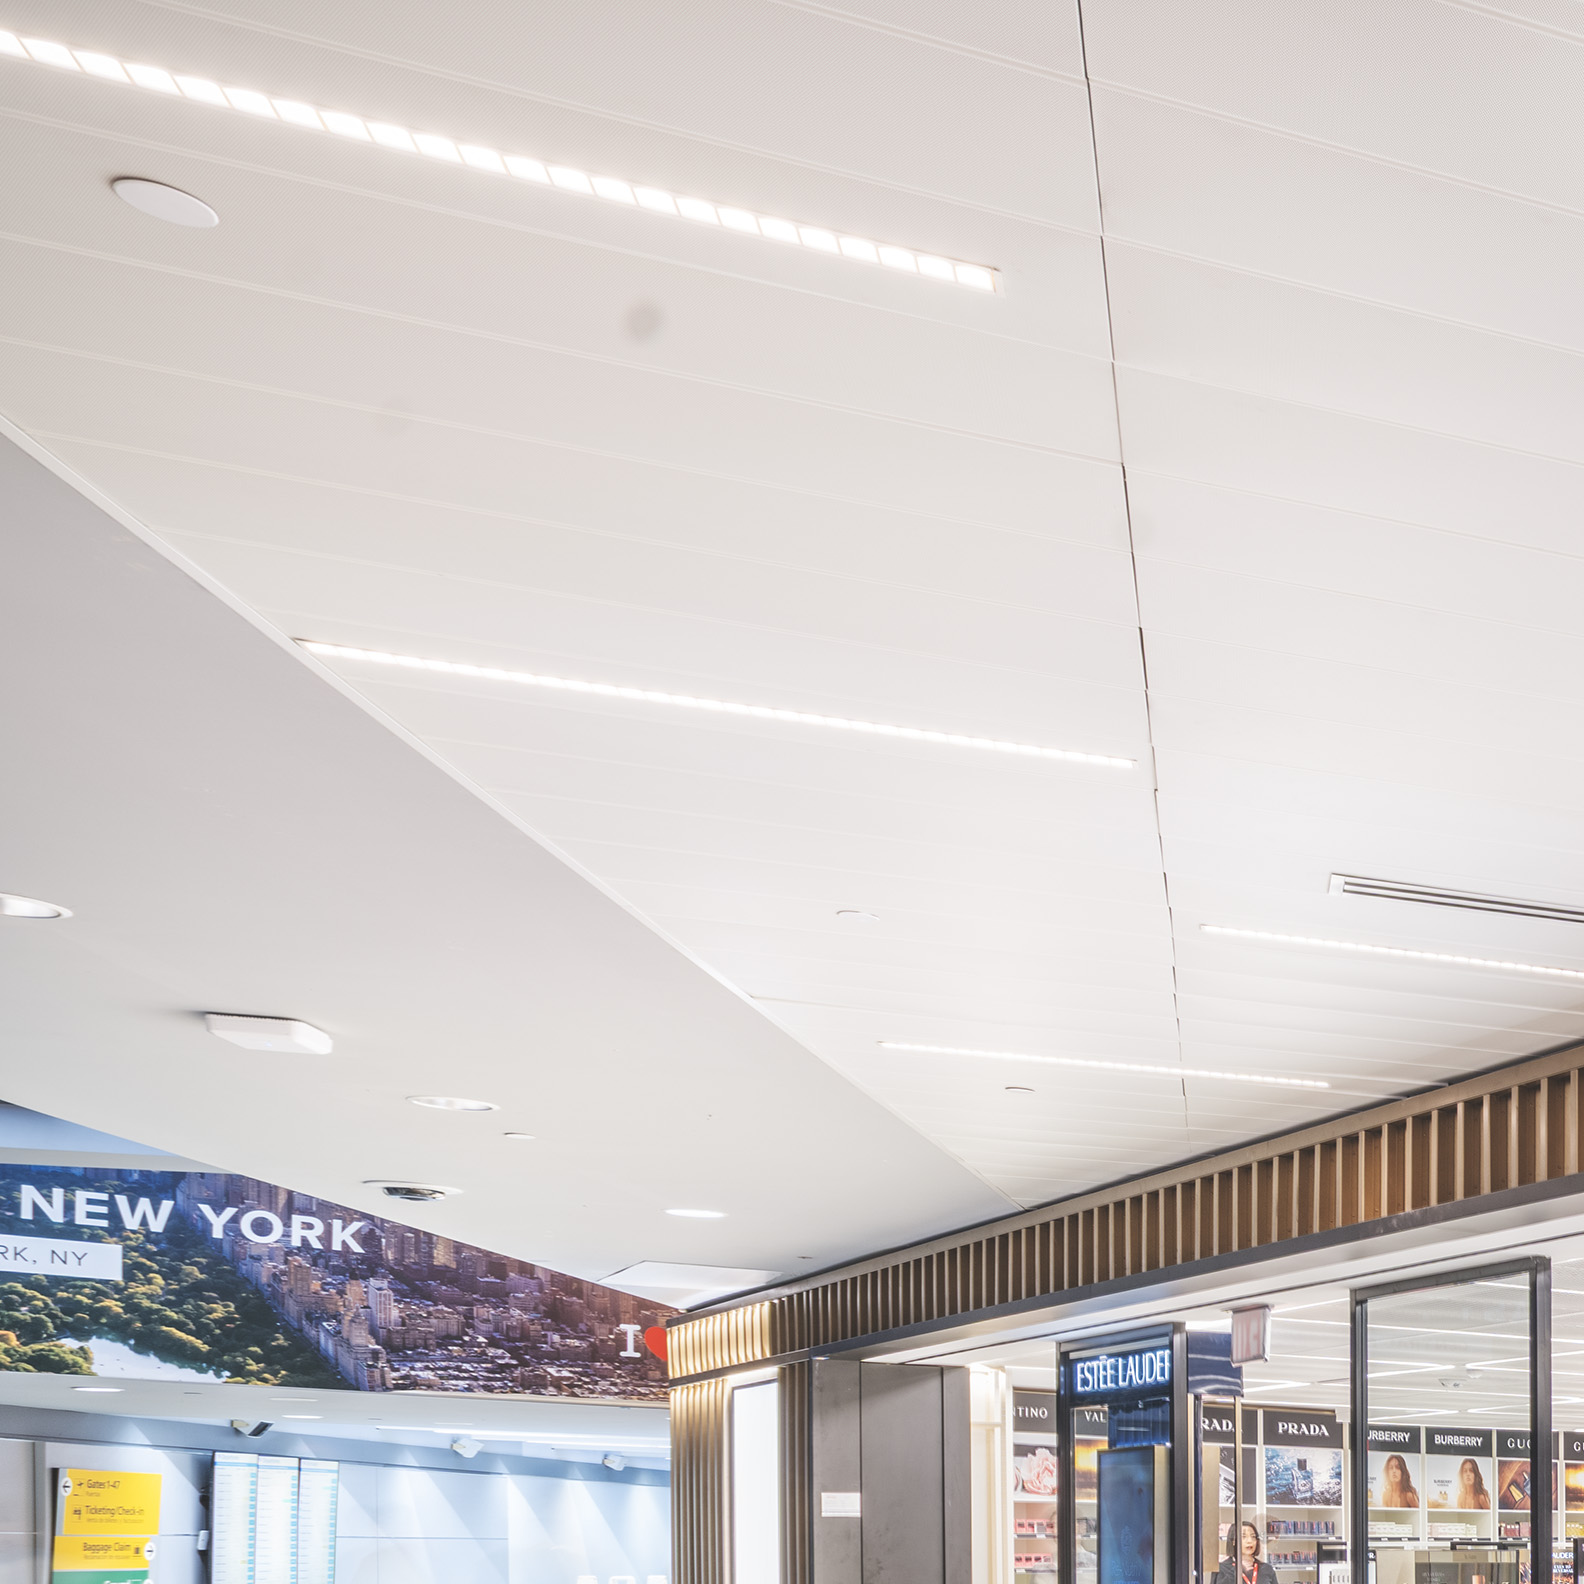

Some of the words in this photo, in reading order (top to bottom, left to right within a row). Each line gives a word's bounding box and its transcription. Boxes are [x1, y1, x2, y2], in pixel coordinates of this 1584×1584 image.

[20, 1184, 174, 1232] NEW
[197, 1203, 365, 1253] YORK
[51, 1249, 88, 1266] NY
[619, 1323, 641, 1357] I
[1278, 1421, 1330, 1437] PRADA
[1434, 1434, 1483, 1447] BURBERRY
